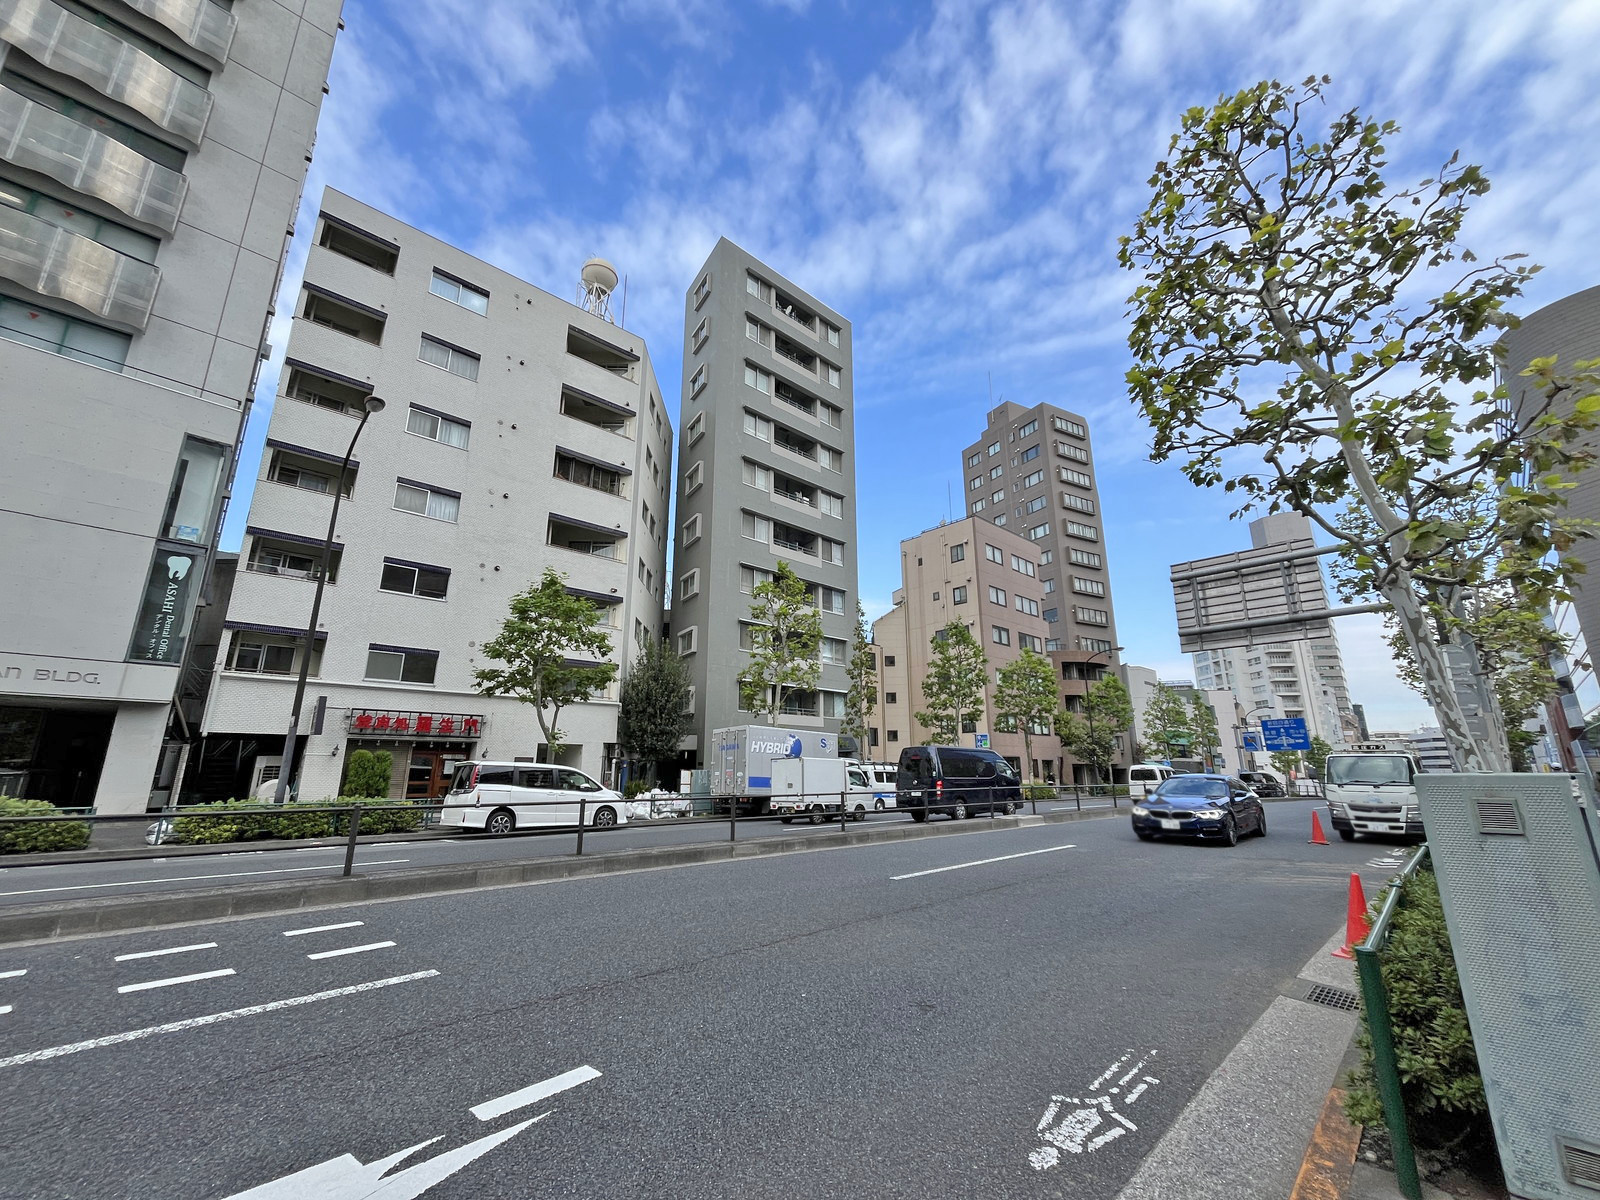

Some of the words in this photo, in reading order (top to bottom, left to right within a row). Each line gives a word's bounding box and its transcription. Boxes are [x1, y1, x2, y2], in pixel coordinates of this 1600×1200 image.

[162, 582, 178, 613] ASAHI
[162, 615, 175, 638] Dental
[156, 639, 169, 659] Office
[33, 669, 101, 684] BLDG.
[750, 741, 791, 755] HYBRID
